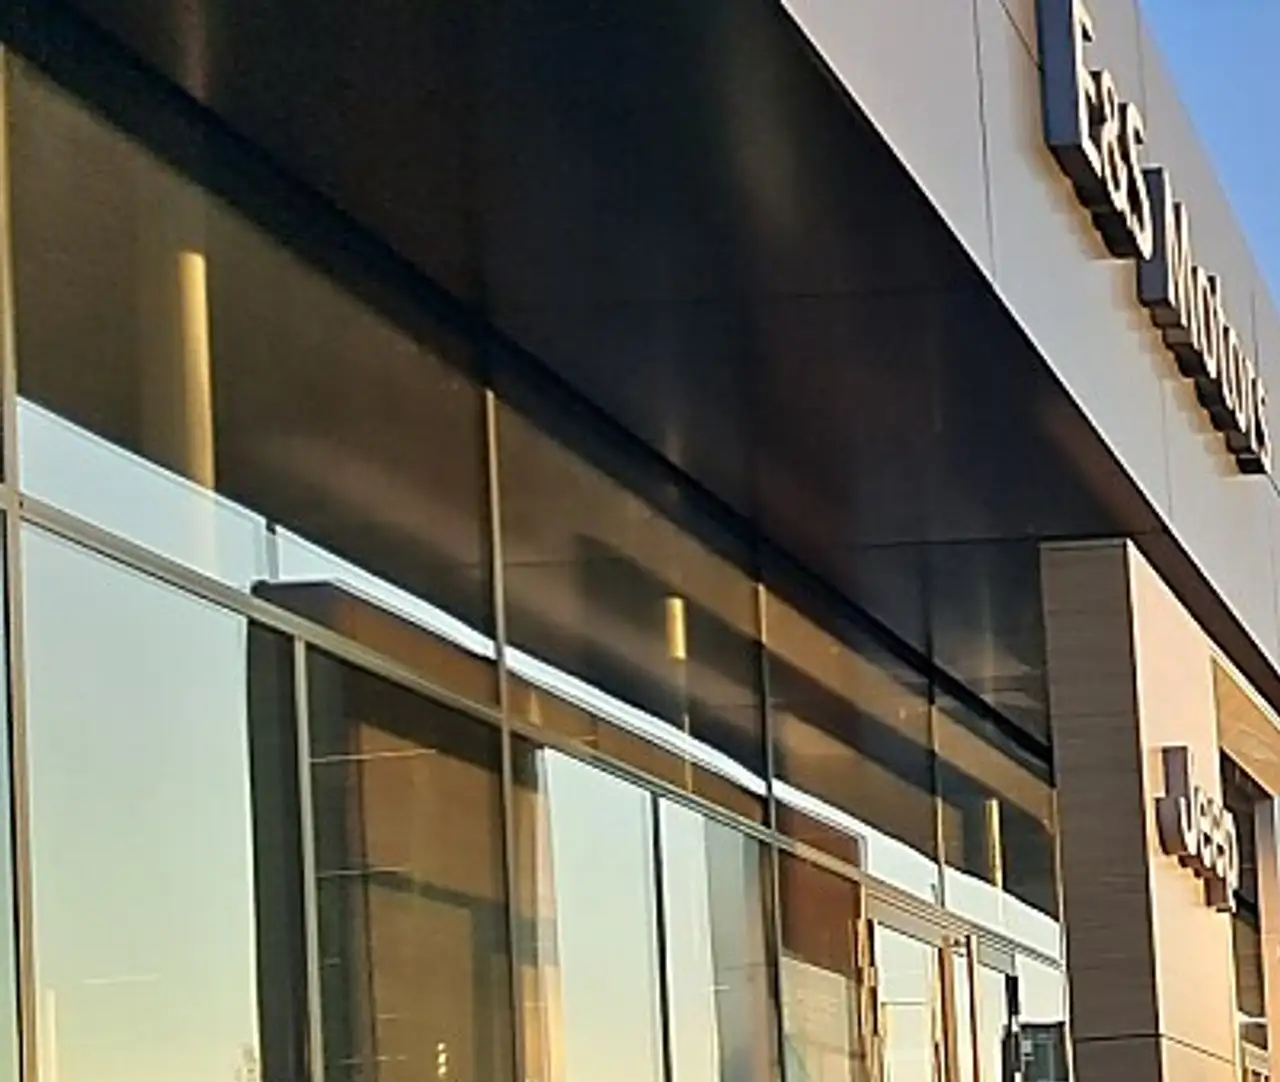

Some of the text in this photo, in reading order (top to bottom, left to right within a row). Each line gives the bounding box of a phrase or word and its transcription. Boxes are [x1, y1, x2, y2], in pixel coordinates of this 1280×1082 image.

[1071, 0, 1272, 474] E&S Motors
[1180, 743, 1239, 913] Jeep
